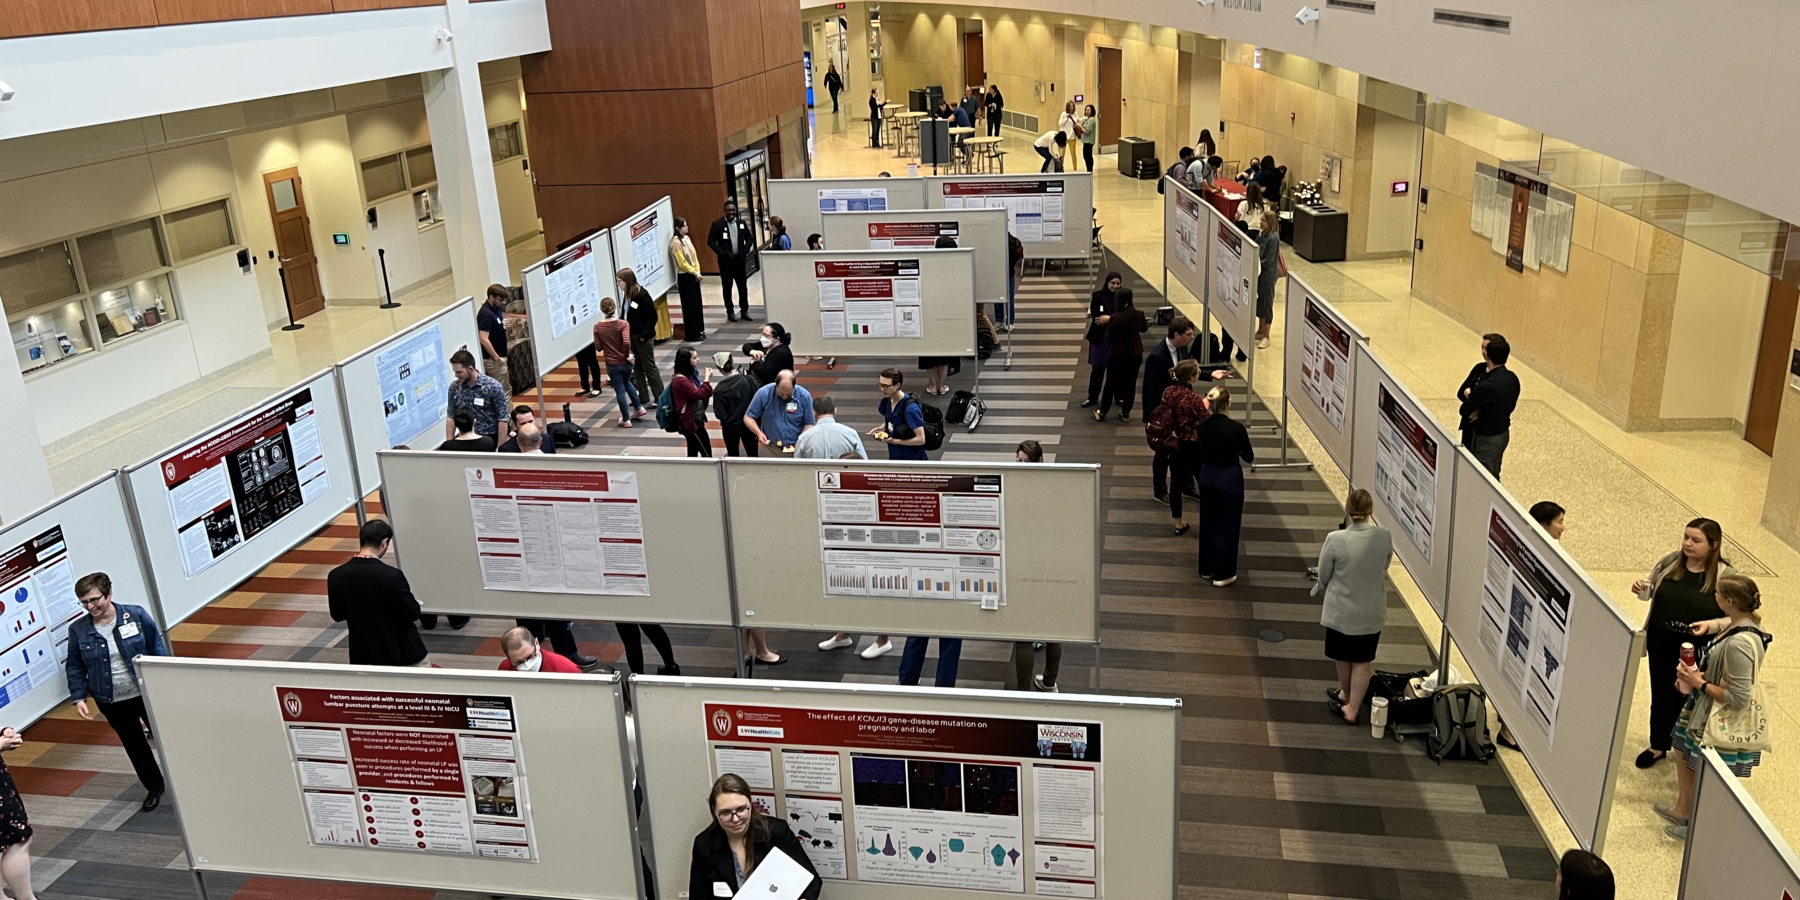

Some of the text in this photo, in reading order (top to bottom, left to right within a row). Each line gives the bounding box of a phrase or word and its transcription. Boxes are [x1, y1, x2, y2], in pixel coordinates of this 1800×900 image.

[183, 448, 201, 460] Adapting
[232, 423, 251, 435] Framework
[823, 713, 846, 721] effect
[888, 716, 939, 726] gene-disease
[859, 724, 899, 733] pregnancy
[1729, 718, 1766, 742] CHICAGO
